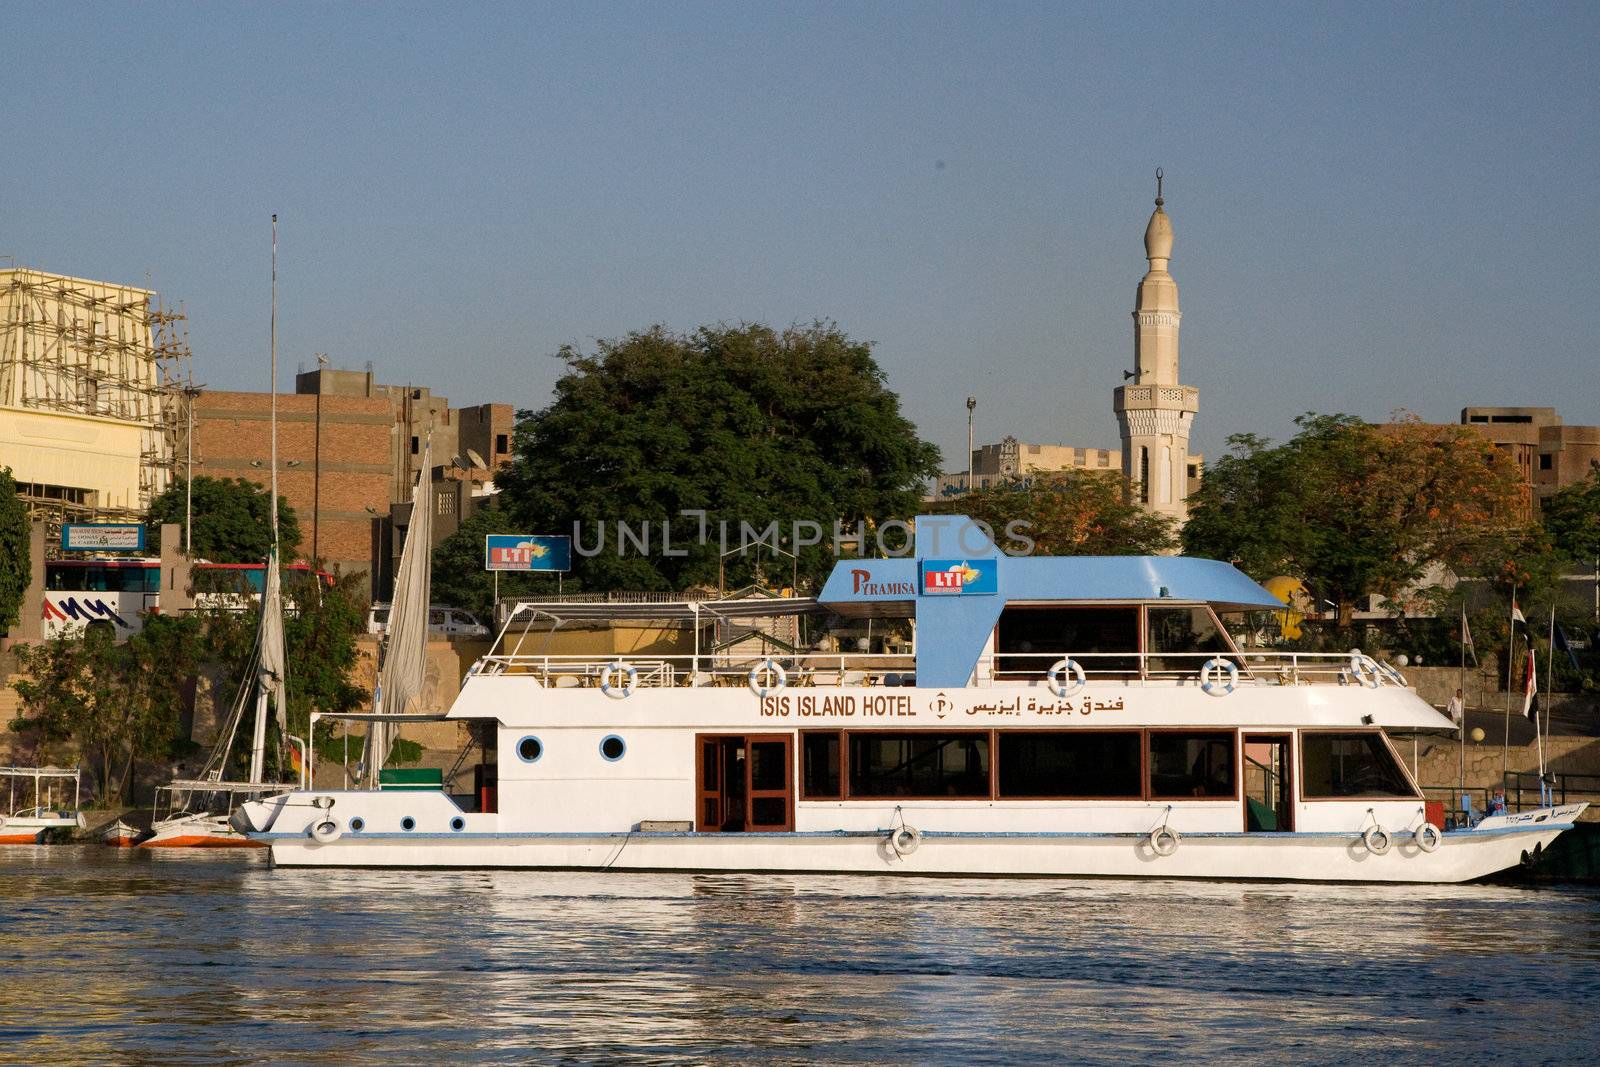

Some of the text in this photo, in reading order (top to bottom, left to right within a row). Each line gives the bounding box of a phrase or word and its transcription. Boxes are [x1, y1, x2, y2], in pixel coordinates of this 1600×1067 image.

[501, 549, 530, 562] LTI
[935, 572, 962, 587] LTI
[760, 695, 917, 717] ISIS ISLAND HOTEL
[965, 695, 1124, 717] فندق جزيرة إيزيس
